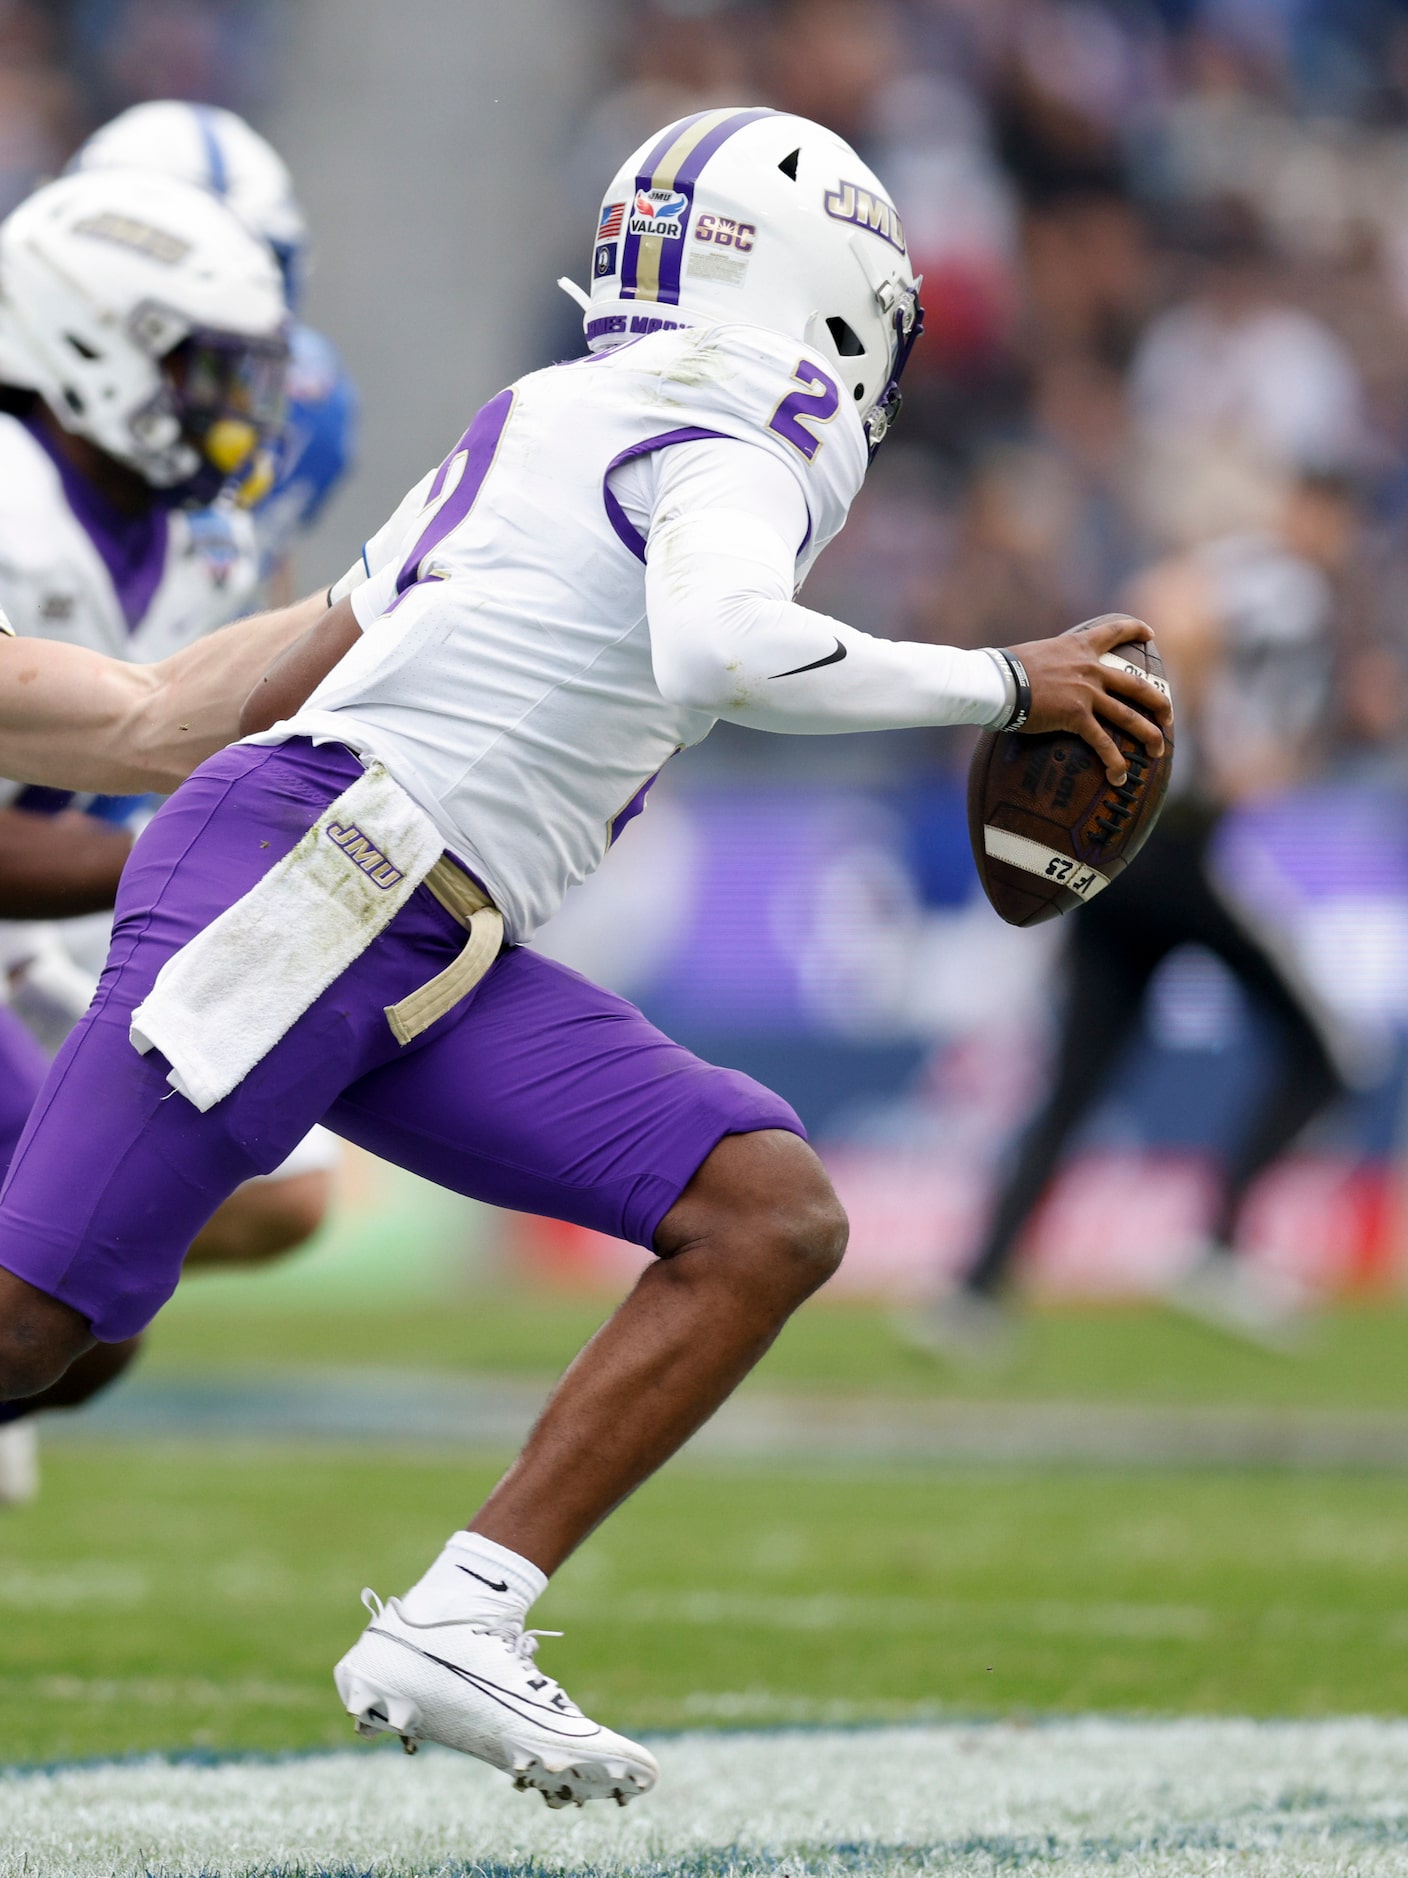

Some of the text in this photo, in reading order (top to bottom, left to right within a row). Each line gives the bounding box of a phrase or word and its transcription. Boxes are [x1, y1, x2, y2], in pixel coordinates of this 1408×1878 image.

[648, 191, 673, 201] JMU
[631, 219, 679, 236] VALOR
[695, 214, 756, 252] SBC
[766, 357, 839, 465] 2
[326, 822, 405, 890] JMU
[1045, 857, 1073, 880] 23
